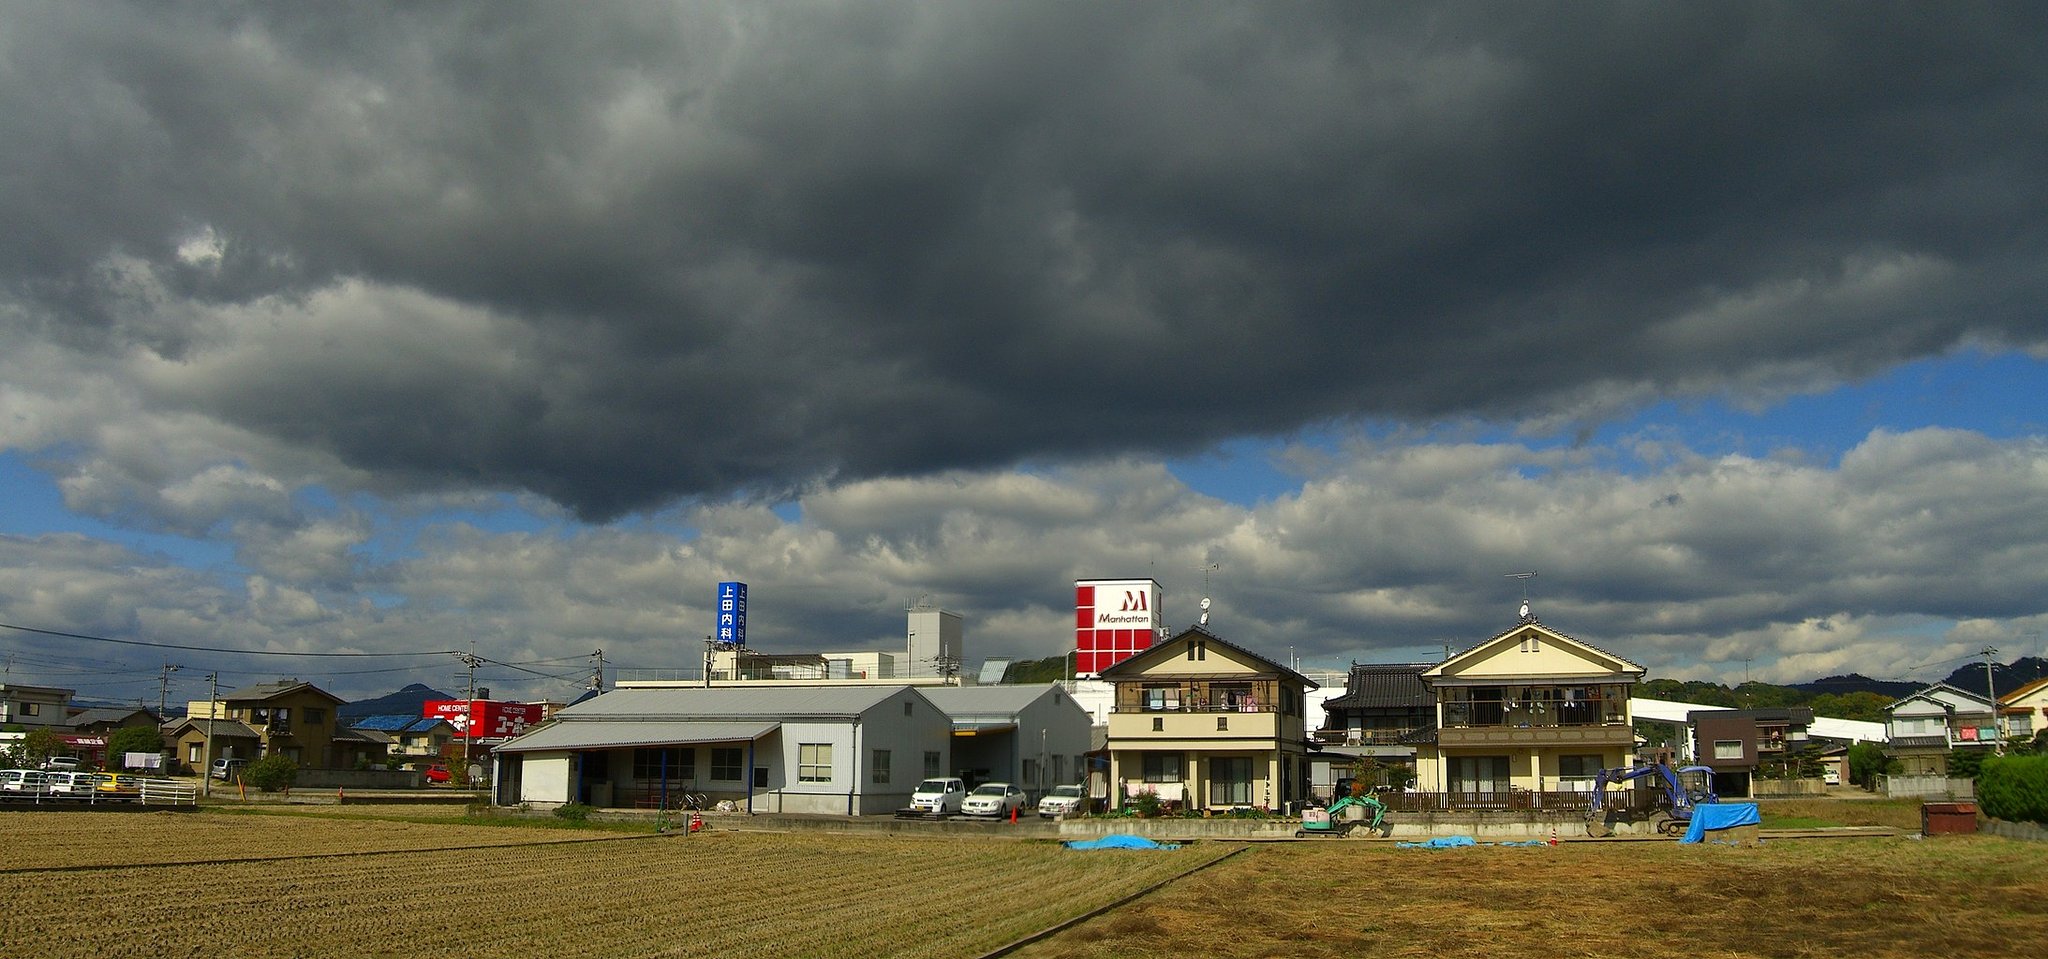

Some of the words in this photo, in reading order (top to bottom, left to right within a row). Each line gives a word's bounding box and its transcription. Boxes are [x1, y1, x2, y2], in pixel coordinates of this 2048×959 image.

[1119, 590, 1147, 611] M
[721, 586, 733, 639] 上田内科
[1098, 613, 1149, 623] Manhattan
